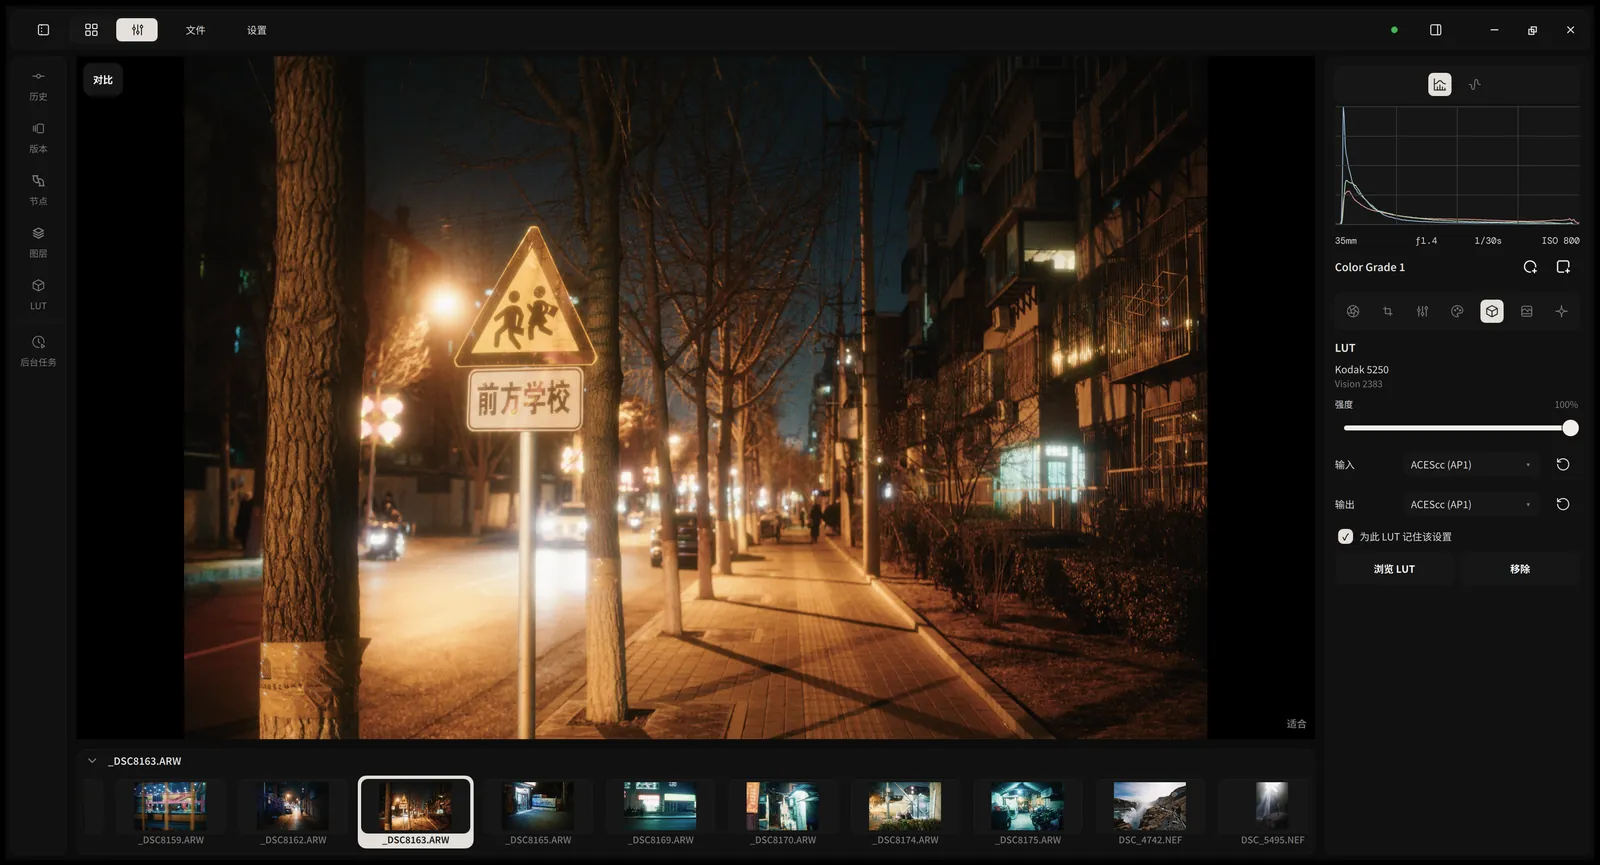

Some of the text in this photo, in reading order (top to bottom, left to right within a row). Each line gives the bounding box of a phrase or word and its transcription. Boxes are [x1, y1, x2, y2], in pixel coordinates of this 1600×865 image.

[185, 24, 206, 36] 文件
[246, 24, 267, 36] 设置
[92, 74, 114, 86] 对比
[29, 91, 48, 102] 历史
[28, 143, 48, 154] 版本
[29, 196, 48, 206] 节点
[1334, 236, 1358, 245] 35mm
[1474, 236, 1502, 246] 1/30s
[1541, 236, 1581, 245] ISO 800
[29, 248, 48, 259] 图层
[1334, 261, 1406, 273] Color Grade 1
[30, 301, 48, 311] LUT
[1335, 343, 1356, 353] LUT
[20, 357, 57, 368] 后台任务
[1334, 364, 1390, 375] Kodak 5250
[1334, 379, 1383, 389] Vision 2383
[477, 380, 570, 416] 前方学校
[1334, 399, 1354, 410] 强度
[1554, 400, 1579, 409] 100%
[1334, 459, 1356, 470] 输入
[1410, 459, 1472, 471] ACEScc (AP1)
[1334, 499, 1355, 510] 输出
[1410, 499, 1472, 511] ACEScc (AP1)
[1359, 531, 1452, 543] 为此 LUT 记住该设置
[1373, 563, 1416, 575] 浏览 LUT
[1509, 563, 1531, 575] 移除
[1286, 718, 1307, 730] 适合
[107, 756, 182, 768] _DSC8163.ARW
[137, 835, 205, 846] _DSC8159.ARW
[259, 835, 327, 846] _DSC8162.ARW
[381, 835, 450, 846] _DSC8163.ARW
[504, 835, 572, 846] _DSC8165.ARW
[627, 835, 695, 846] _DSC8169.ARW
[749, 835, 817, 846] _DSC8170.ARW
[871, 835, 939, 846] _DSC8174.ARW
[994, 835, 1062, 846] _DSC8175.ARW
[1118, 835, 1183, 846] DSC_4742.NEF
[1241, 835, 1305, 846] DSC_5495.NEF
